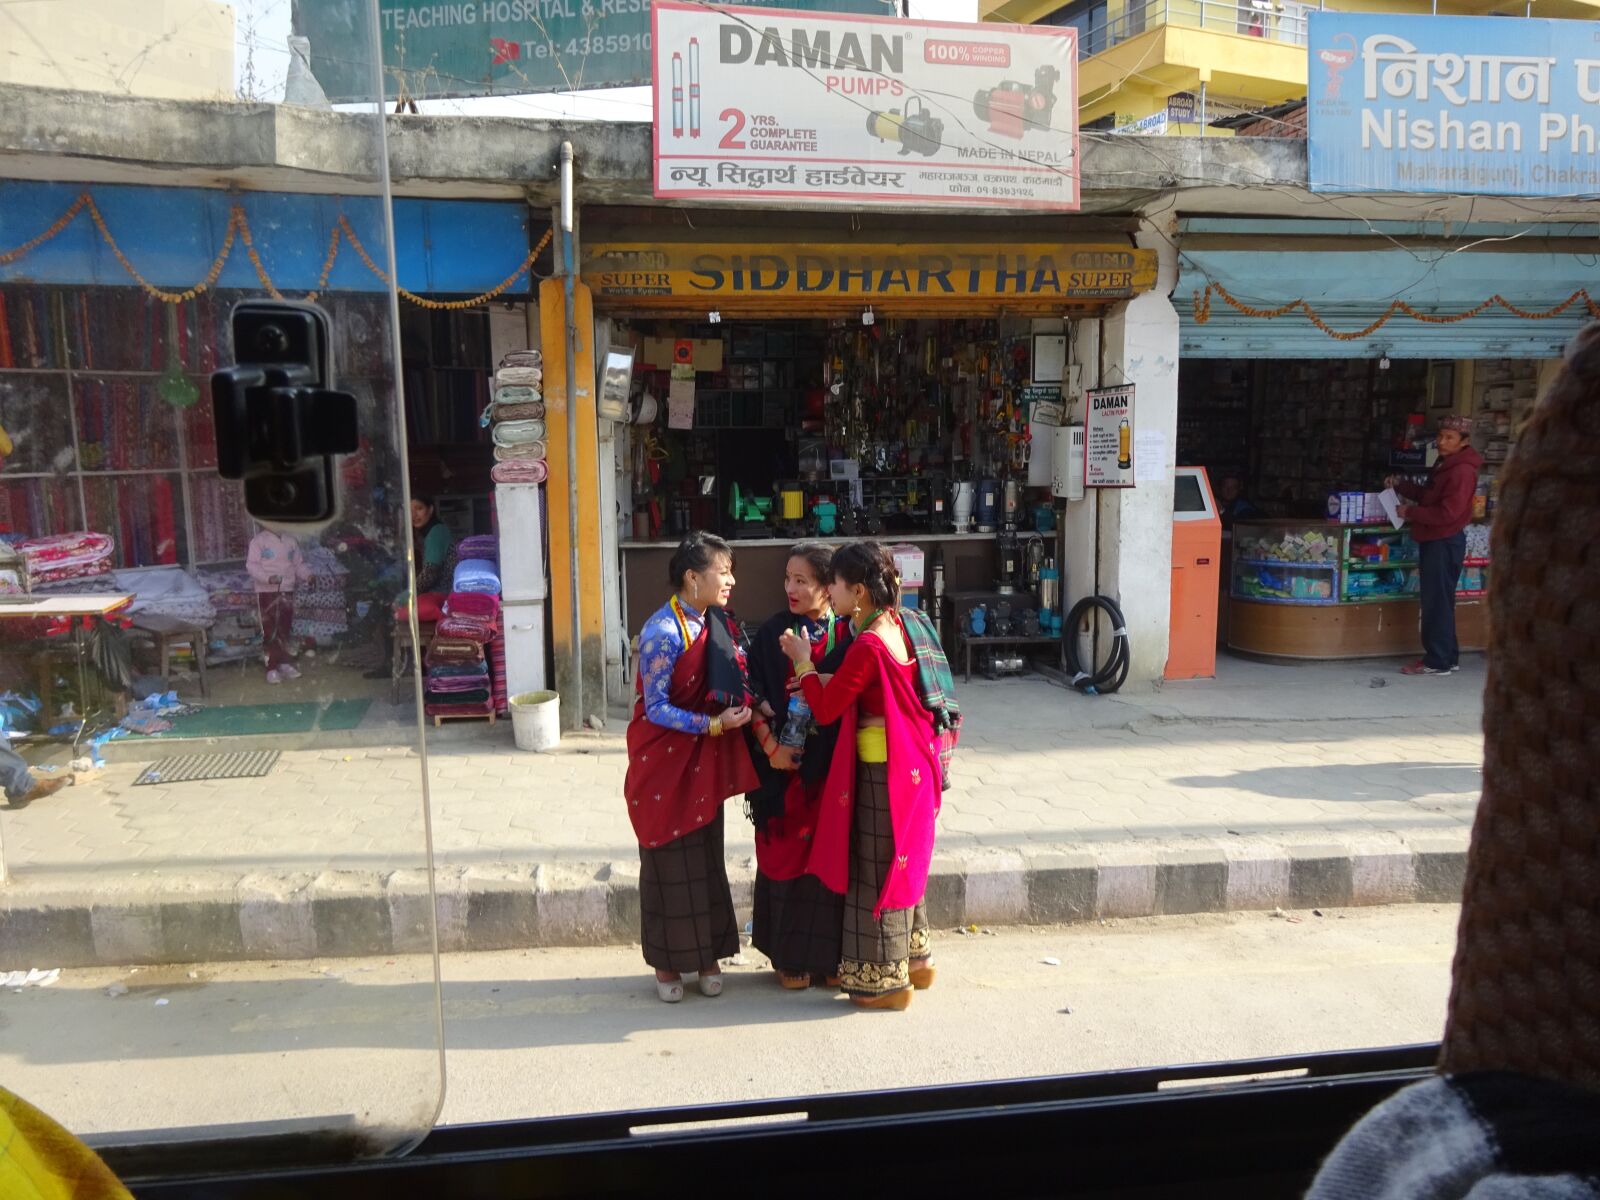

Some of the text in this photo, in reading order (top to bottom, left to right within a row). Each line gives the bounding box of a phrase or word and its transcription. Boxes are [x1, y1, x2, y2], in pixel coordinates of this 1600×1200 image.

[381, 3, 476, 30] TEACHING
[483, 0, 576, 22] HOSPITAL
[582, 0, 595, 16] &
[523, 33, 651, 59] Tel: 4385910
[719, 23, 904, 74] DAMAN
[928, 44, 1005, 61] 100% COPPER
[972, 54, 1007, 63] WINDING
[1361, 34, 1556, 105] निशान
[826, 75, 904, 96] PUMPS
[1168, 97, 1194, 108] ABROAD
[1170, 107, 1191, 118] STUDY
[719, 108, 779, 149] 2 YRS.
[1140, 113, 1166, 129] ABROAD
[750, 127, 817, 140] COMPLETE
[1361, 109, 1600, 153] Nishan Ph
[750, 140, 818, 152] GUARANTEE
[957, 147, 1062, 163] MADE IN NEPAL
[670, 167, 711, 187] न्यू
[805, 166, 906, 188] हार्डवेयर
[601, 273, 671, 286] SUPER
[688, 253, 1061, 294] SIDDHARTHA
[1069, 272, 1133, 288] SUPER
[1093, 395, 1128, 410] DAMAN
